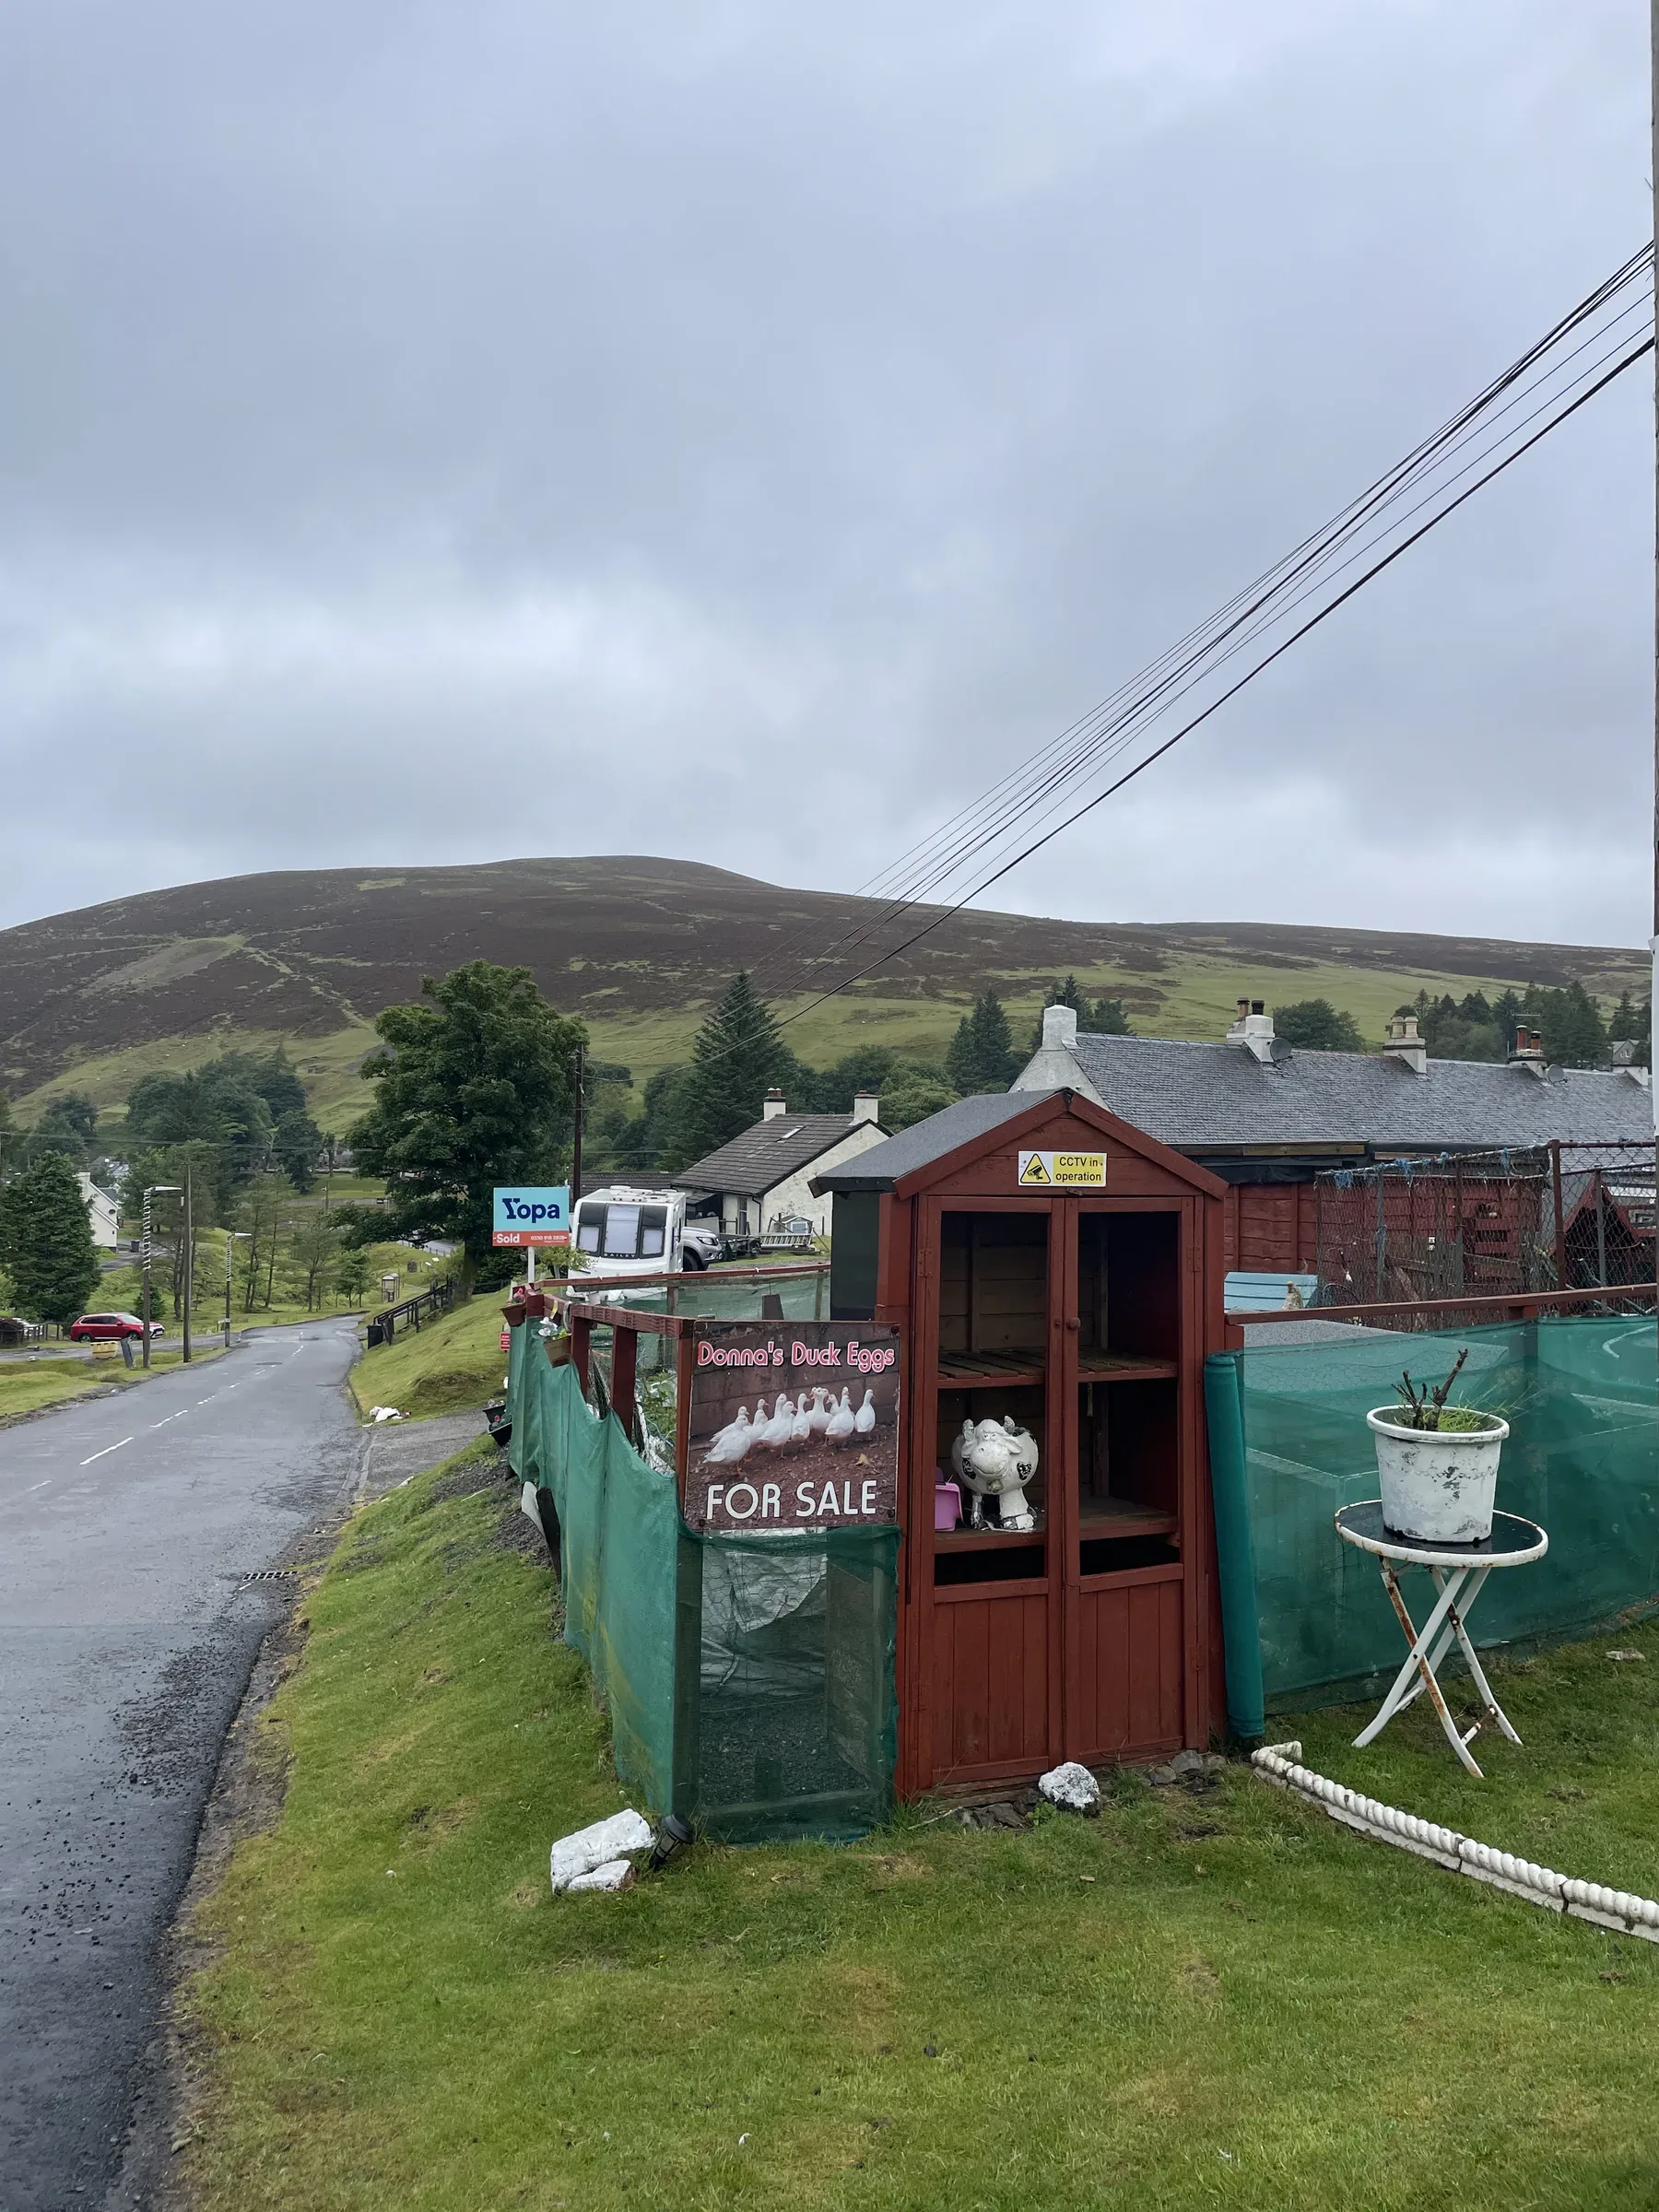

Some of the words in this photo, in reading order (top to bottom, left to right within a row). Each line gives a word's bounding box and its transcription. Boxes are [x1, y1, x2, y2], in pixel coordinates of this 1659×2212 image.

[1059, 1157, 1087, 1167] CCTV
[1089, 1158, 1098, 1167] in
[1056, 1172, 1101, 1182] operation
[502, 1198, 560, 1224] Yopa
[496, 1233, 521, 1243] Sold
[697, 1341, 783, 1367] Donna's
[791, 1341, 841, 1366] Duck
[847, 1341, 895, 1373] Eggs
[706, 1483, 782, 1520] FOR
[795, 1480, 877, 1517] SALE
